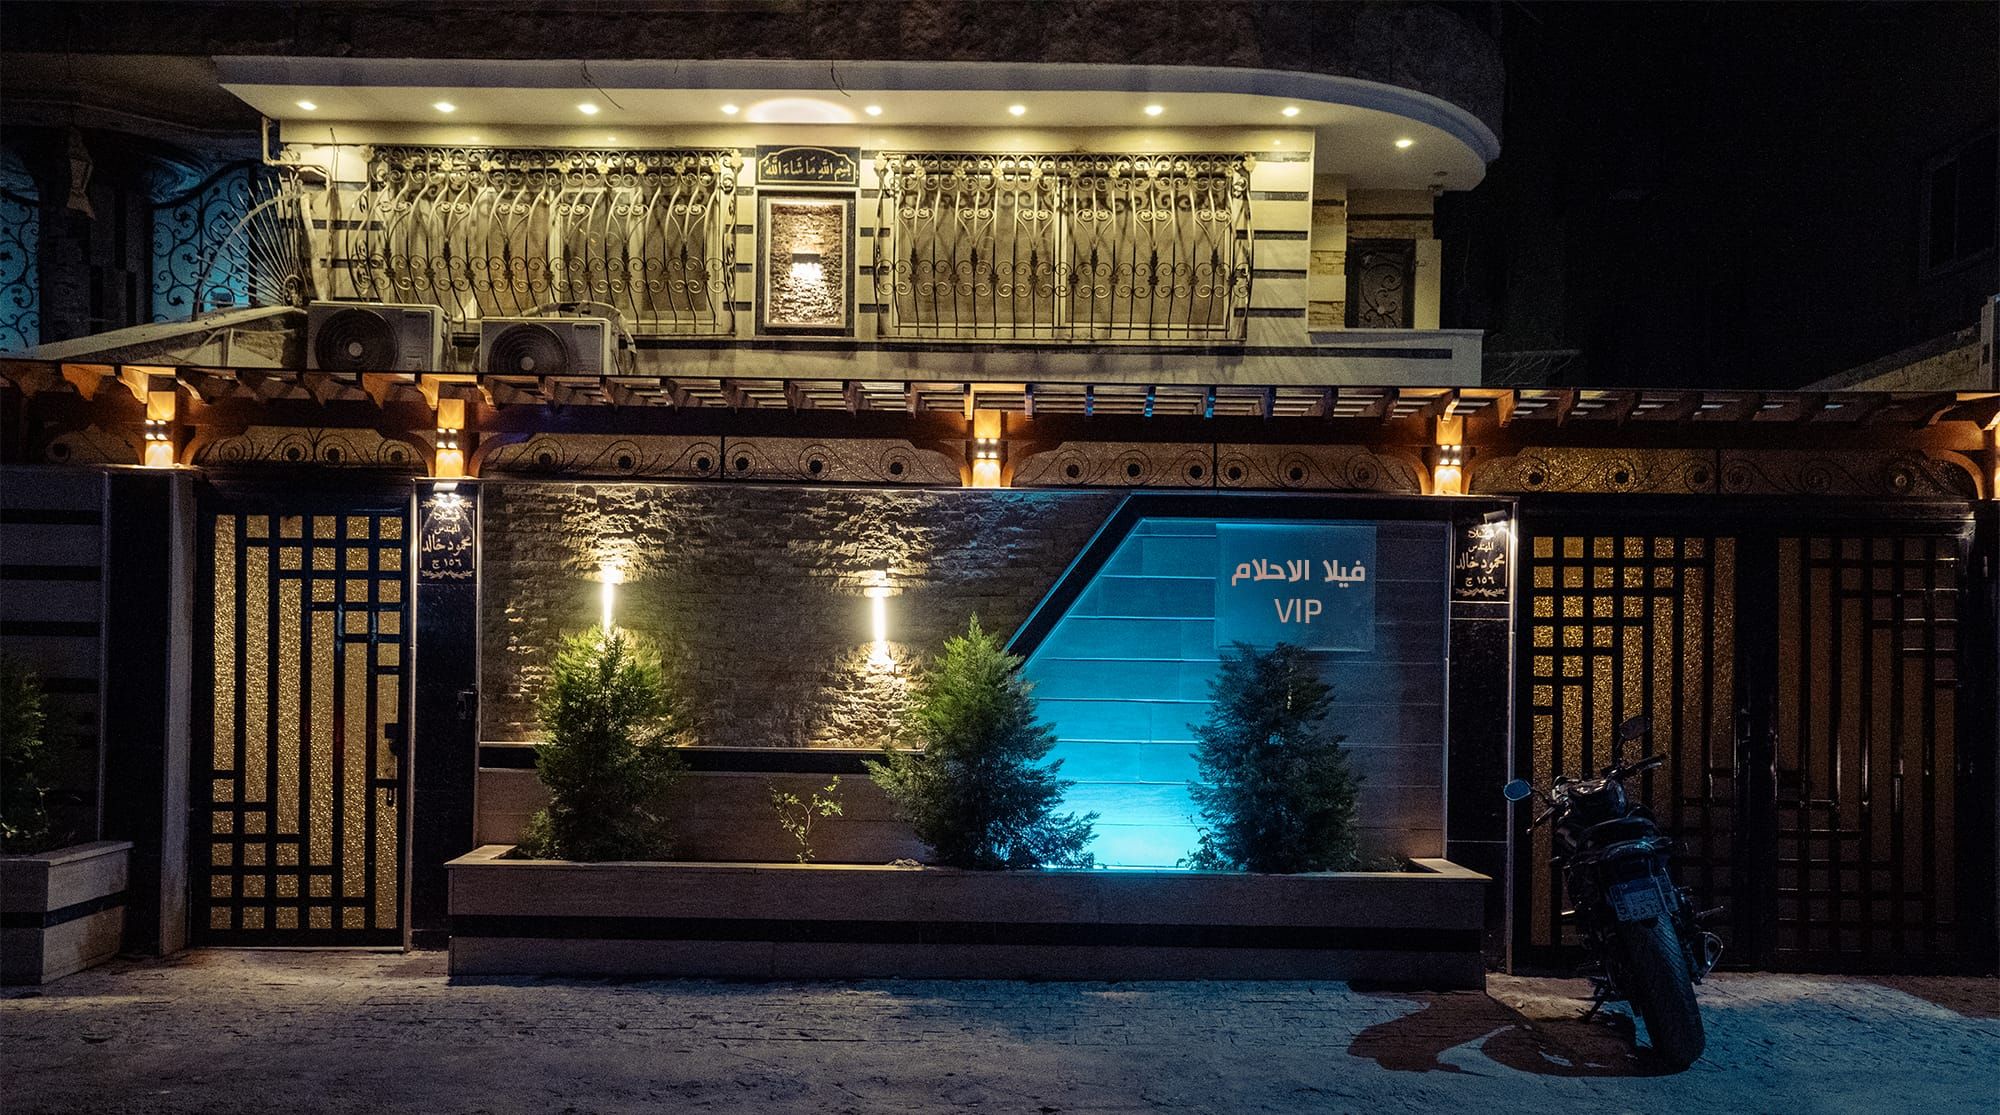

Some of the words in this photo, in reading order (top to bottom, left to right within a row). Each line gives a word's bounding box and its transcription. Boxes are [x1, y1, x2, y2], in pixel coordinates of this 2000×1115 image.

[422, 534, 446, 553] خالد
[447, 536, 472, 556] محمود
[1456, 551, 1480, 570] خالد
[1480, 552, 1505, 574] محمود
[1231, 558, 1310, 587] الاحلام
[1322, 559, 1366, 588] فيلا
[1273, 598, 1323, 624] VIP
